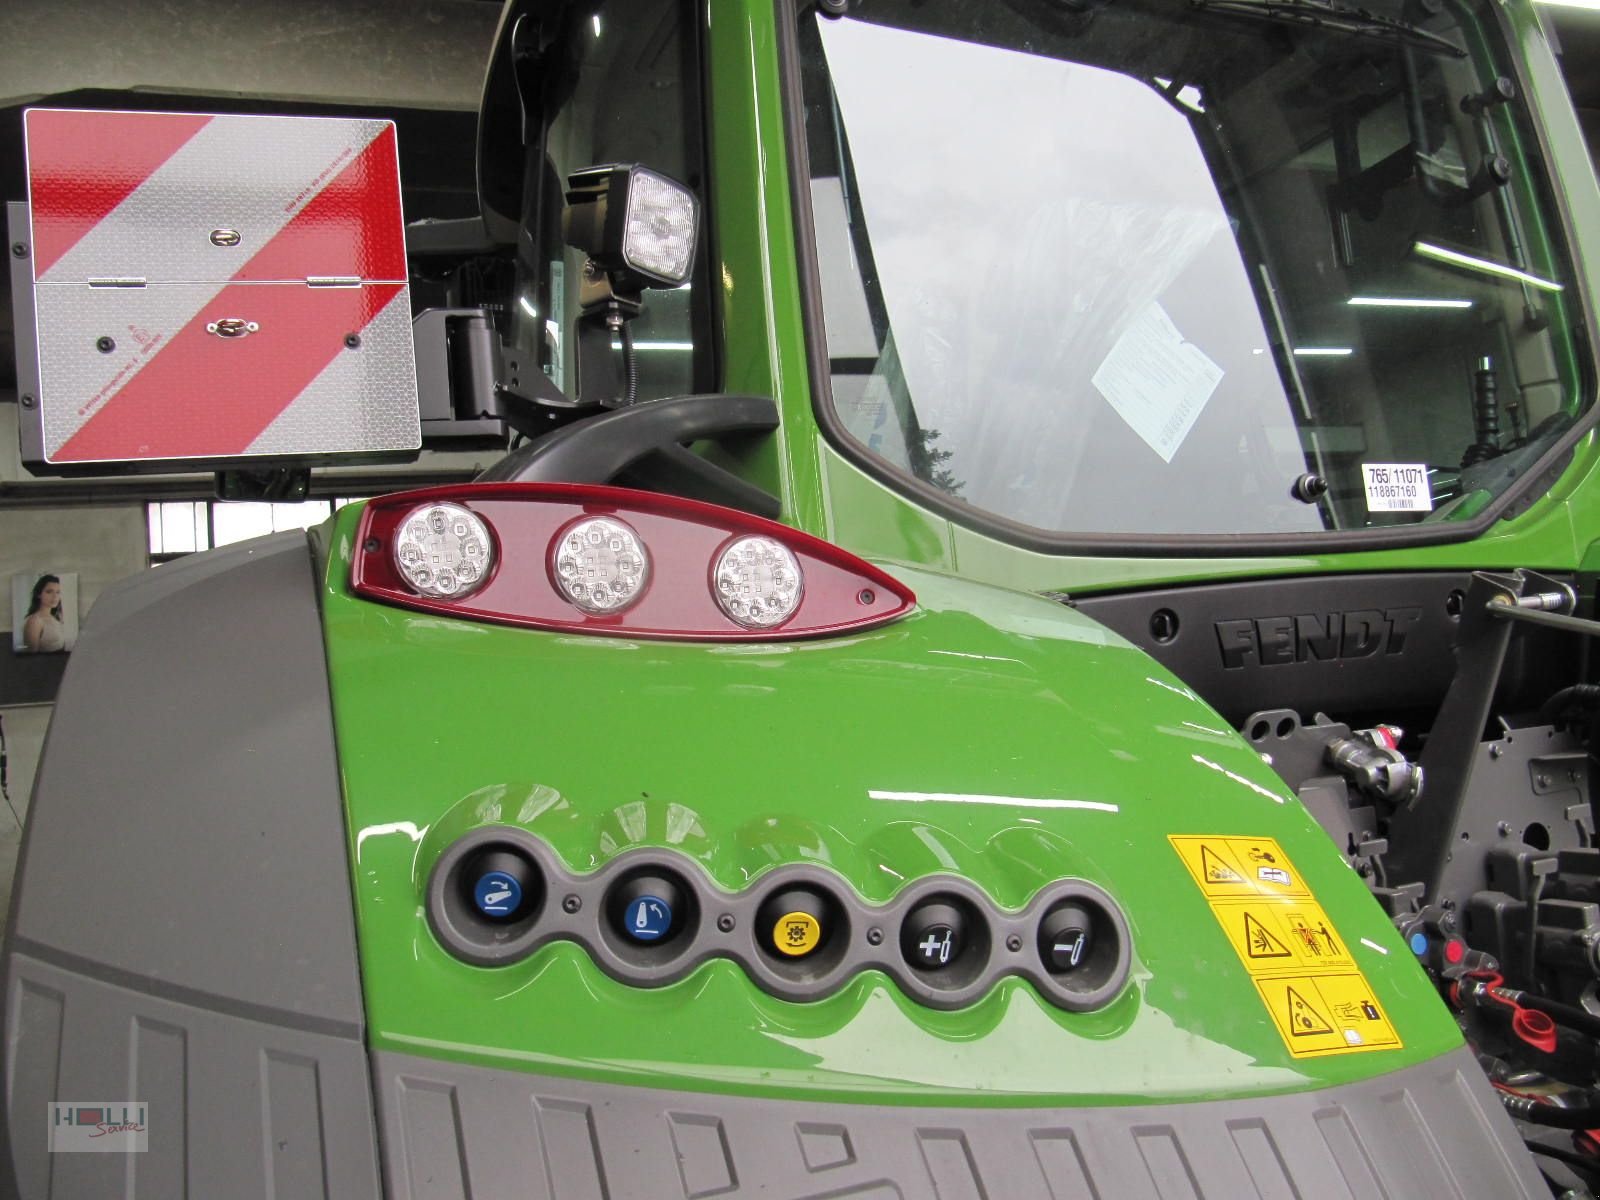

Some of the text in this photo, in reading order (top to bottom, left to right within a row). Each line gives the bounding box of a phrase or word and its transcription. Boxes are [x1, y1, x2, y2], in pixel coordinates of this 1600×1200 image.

[1369, 468, 1424, 484] 765/11071
[1368, 485, 1417, 498] 118867160
[1214, 606, 1423, 670] FENDT
